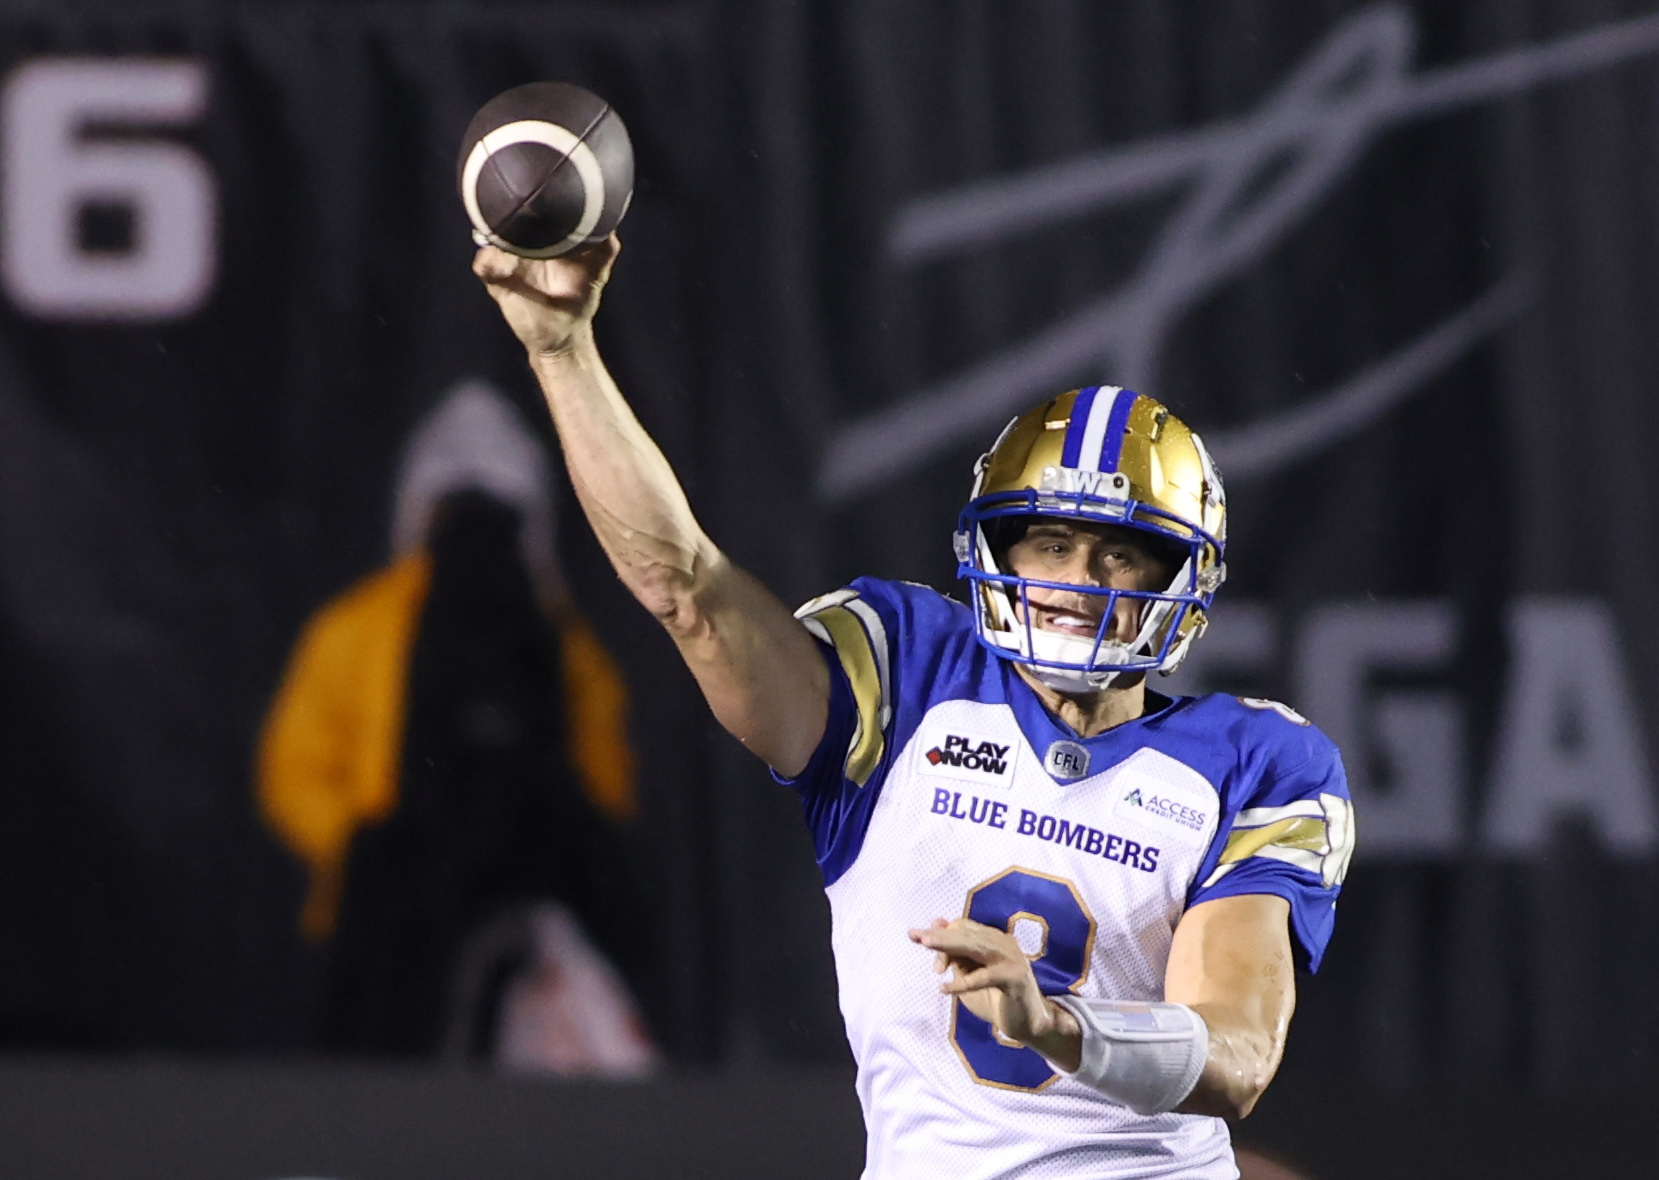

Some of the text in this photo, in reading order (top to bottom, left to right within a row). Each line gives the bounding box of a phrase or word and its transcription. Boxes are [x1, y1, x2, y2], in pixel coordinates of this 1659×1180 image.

[2, 55, 216, 325] 6
[1071, 469, 1102, 494] W
[945, 734, 1010, 760] PLAY
[940, 750, 1008, 775] NOW
[1144, 805, 1202, 831] CREDIT UNION
[1147, 795, 1206, 825] ACCESS
[931, 787, 1160, 873] BLUE BOMBERS
